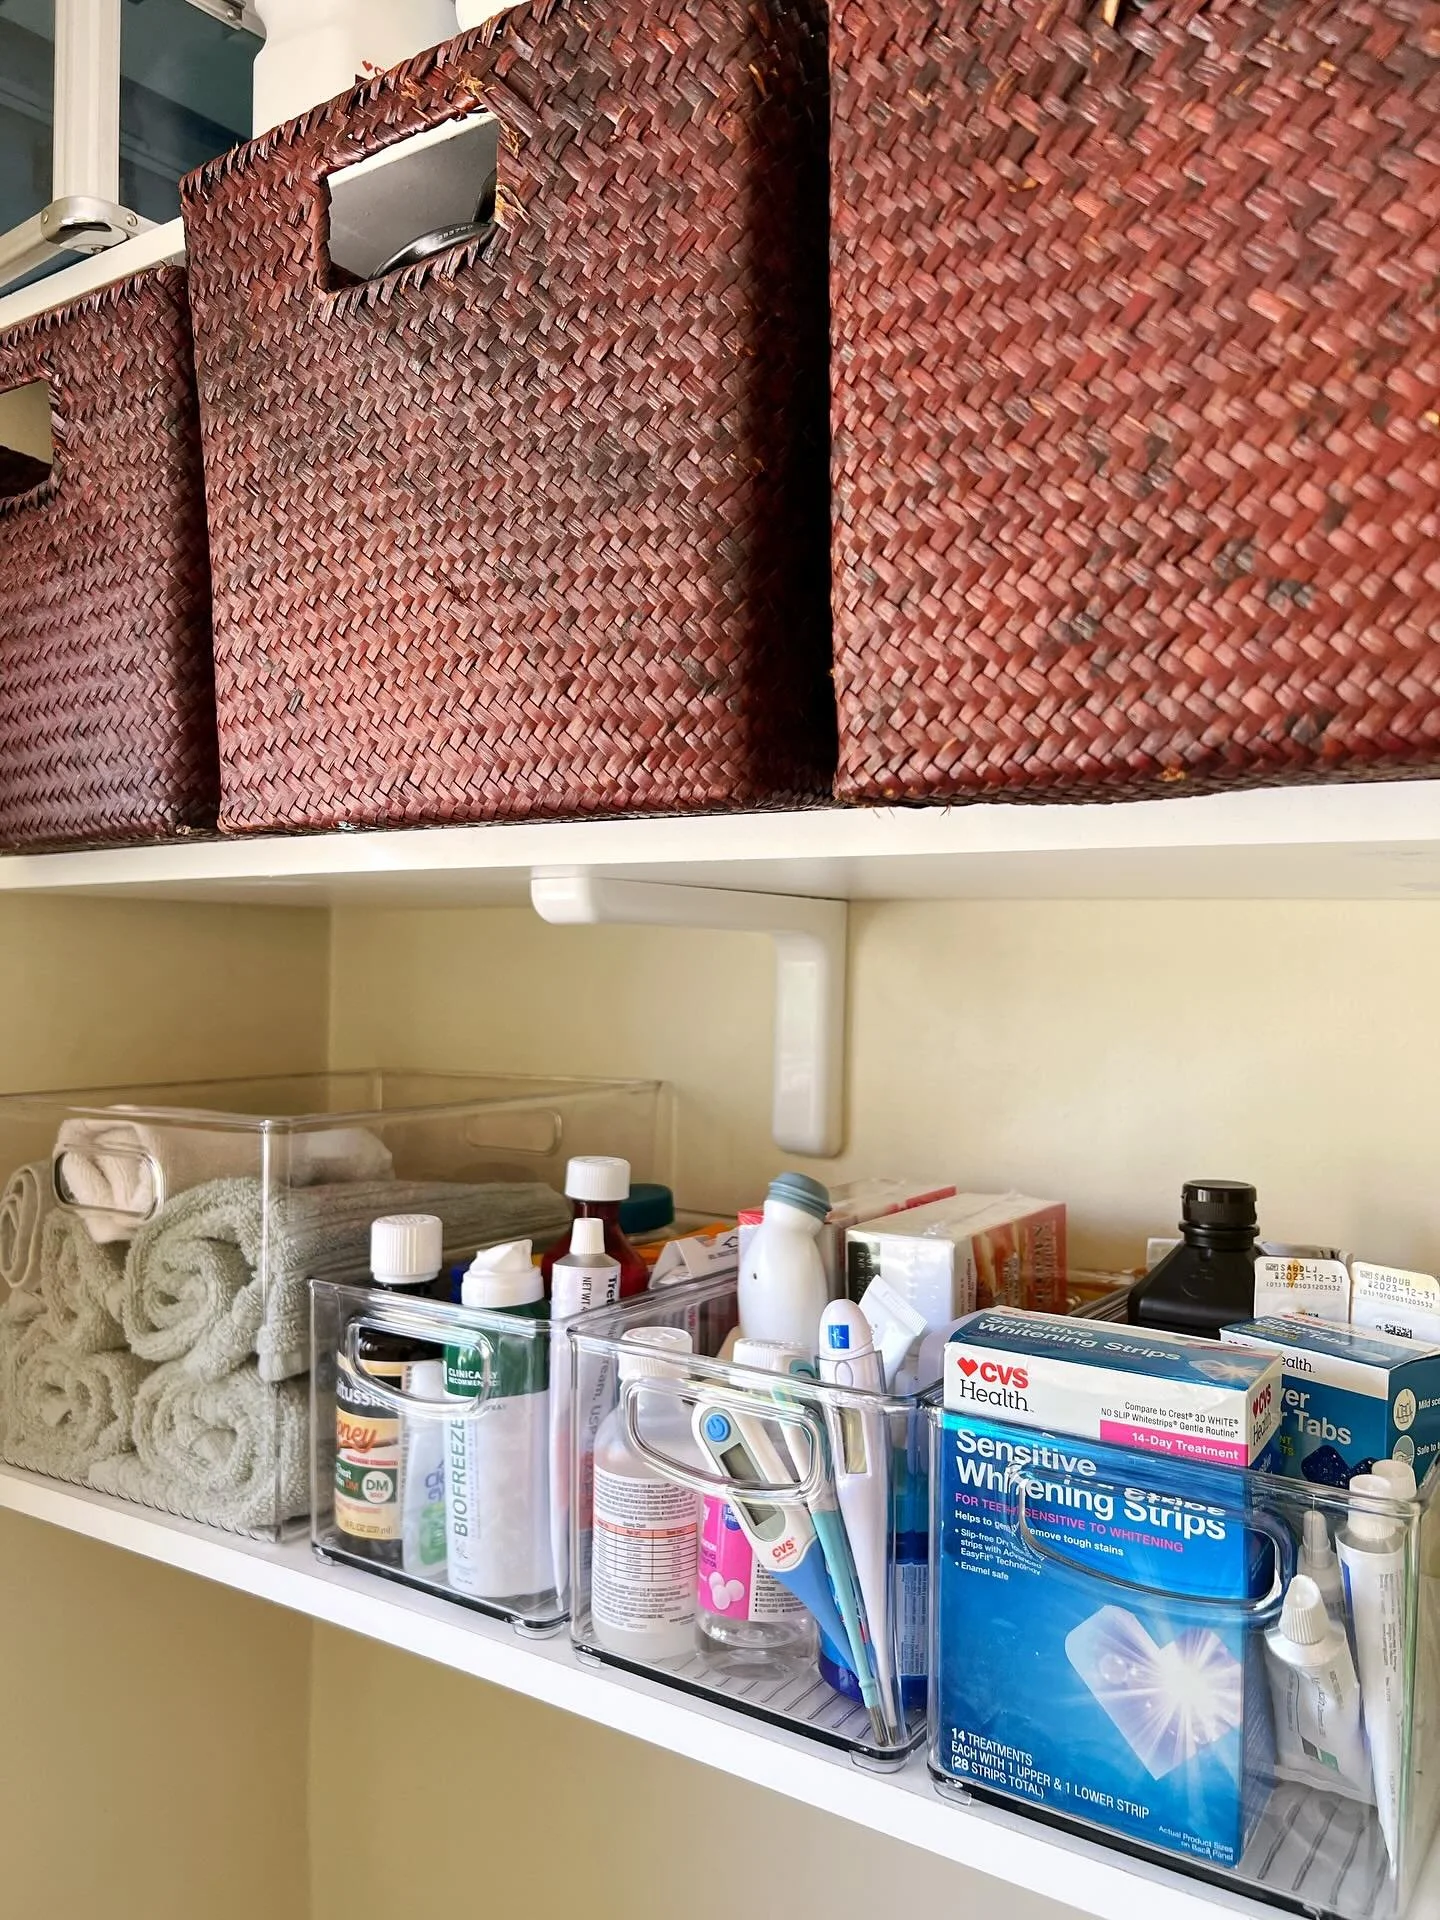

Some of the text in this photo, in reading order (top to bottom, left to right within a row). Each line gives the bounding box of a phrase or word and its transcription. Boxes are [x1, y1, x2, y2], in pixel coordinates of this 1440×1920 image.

[581, 1276, 592, 1291] NET
[606, 1274, 617, 1306] Tret
[1280, 1273, 1343, 1283] 2023-12-31
[580, 1293, 591, 1306] WT
[1373, 1283, 1436, 1301] 2023-12-31
[985, 1316, 1094, 1338] Sensitive
[1309, 1333, 1351, 1346] Tabs
[978, 1322, 1182, 1361] Whitening Strips
[592, 1359, 610, 1401] ream,
[980, 1362, 1029, 1389] CVS
[960, 1379, 1029, 1412] Health
[1258, 1386, 1272, 1414] CVS
[1101, 1408, 1112, 1417] NO
[1114, 1410, 1131, 1420] SLIP
[1179, 1422, 1204, 1434] Gentle
[1125, 1401, 1158, 1415] Compare
[1159, 1407, 1167, 1417] to
[1195, 1414, 1206, 1423] 3D
[1293, 1409, 1352, 1445] Tabs
[956, 1428, 1097, 1477] Sensitive
[1131, 1432, 1240, 1460] 14-Day Treatment
[1416, 1446, 1430, 1456] Safe
[365, 1480, 389, 1491] DM
[451, 1418, 469, 1537] BIOFREEZE
[955, 1493, 979, 1507] FOR
[1024, 1508, 1086, 1531] SENSITIVE
[1089, 1522, 1107, 1535] TO
[1110, 1526, 1184, 1553] WHITENING
[1124, 1498, 1226, 1540] Strips
[955, 1510, 981, 1523] Helps
[983, 1517, 992, 1526] to
[1063, 1535, 1092, 1549] tough
[1094, 1542, 1124, 1556] stains
[960, 1528, 994, 1542] Slip-free
[960, 1539, 983, 1550] strips
[985, 1545, 1001, 1554] with
[772, 1540, 794, 1559] CVS
[961, 1561, 1009, 1581] Enamel safe
[951, 1727, 1033, 1767] 14 TREATMENTS
[951, 1754, 1045, 1800] (28 STRIPS TOTAL)
[951, 1740, 1150, 1819] EACH WITH 1 UPPER & 1 LOWER STRIP
[1159, 1825, 1234, 1853] Actual Product Sizes
[1181, 1841, 1190, 1849] on
[1212, 1849, 1234, 1861] Panel
